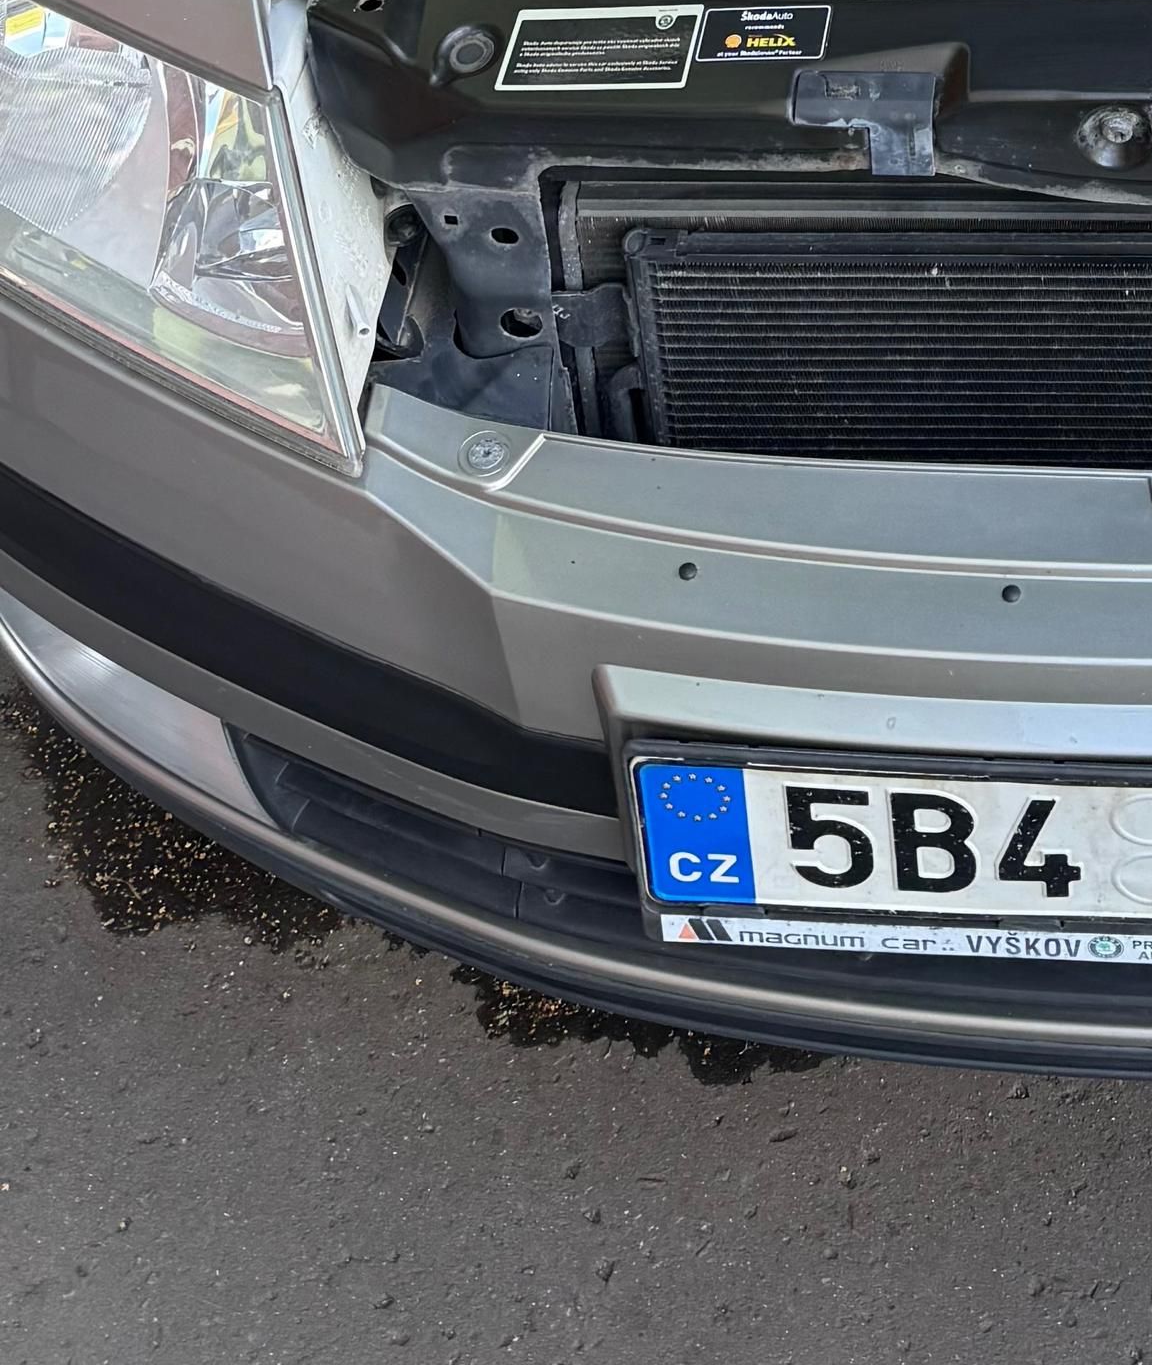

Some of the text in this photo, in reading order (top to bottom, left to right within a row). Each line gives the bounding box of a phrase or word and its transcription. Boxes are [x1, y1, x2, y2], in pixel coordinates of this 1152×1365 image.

[746, 34, 797, 48] HELIX
[785, 785, 1082, 898] 5B4
[668, 851, 740, 884] CZ
[739, 929, 866, 949] magnum
[965, 932, 1082, 958] VYŠKOV
